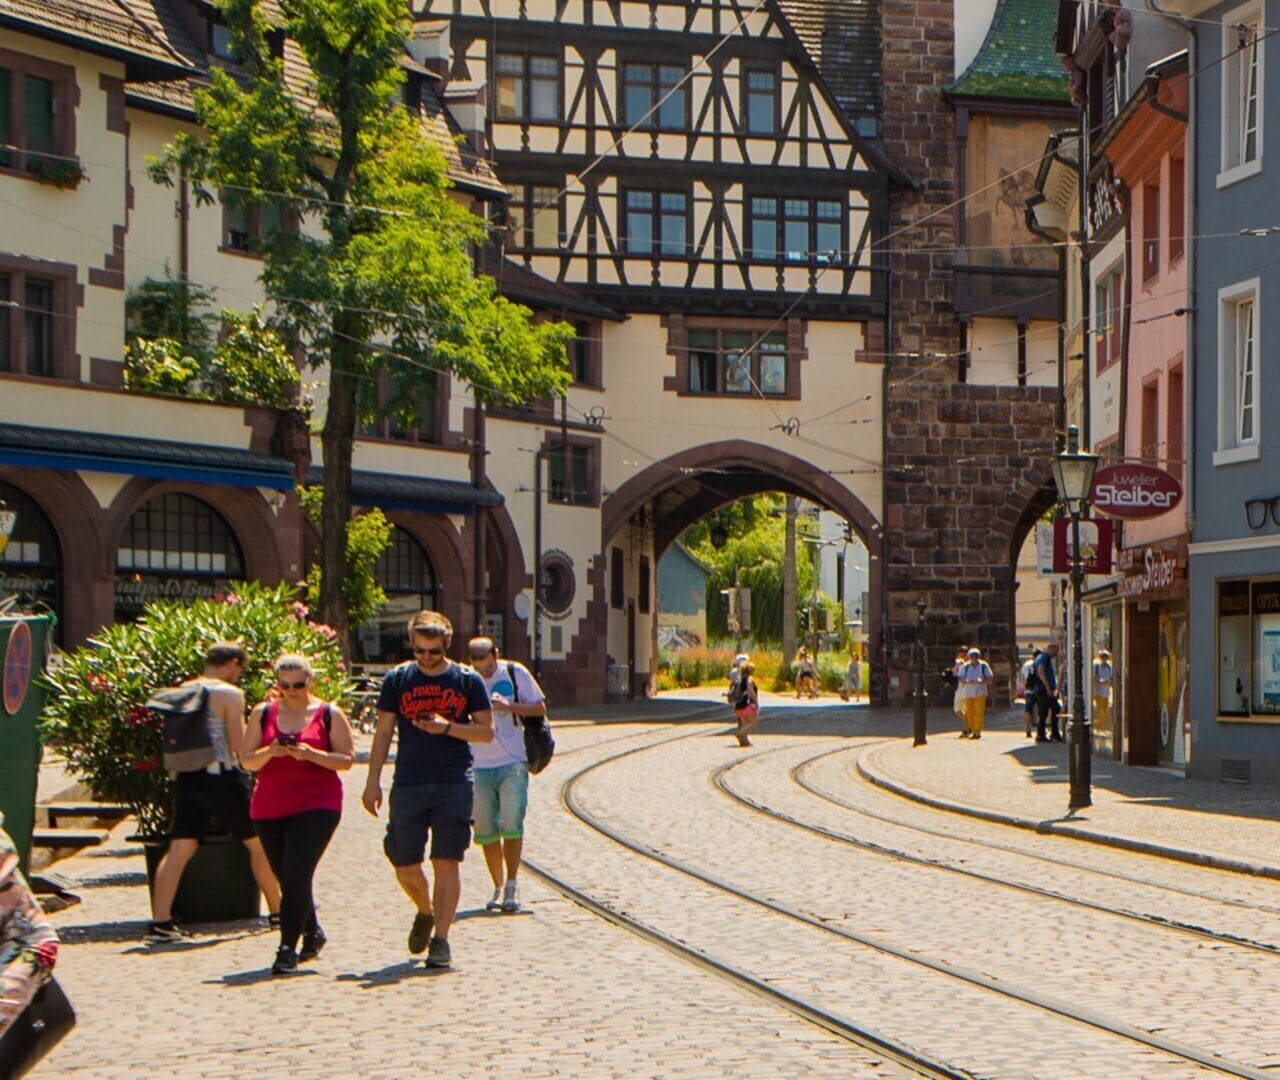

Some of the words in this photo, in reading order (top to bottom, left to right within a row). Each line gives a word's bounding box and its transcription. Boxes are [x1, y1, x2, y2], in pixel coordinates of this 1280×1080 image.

[1110, 472, 1160, 488] Juwelier
[1094, 484, 1178, 508] Steiber
[1142, 548, 1177, 590] Steiber
